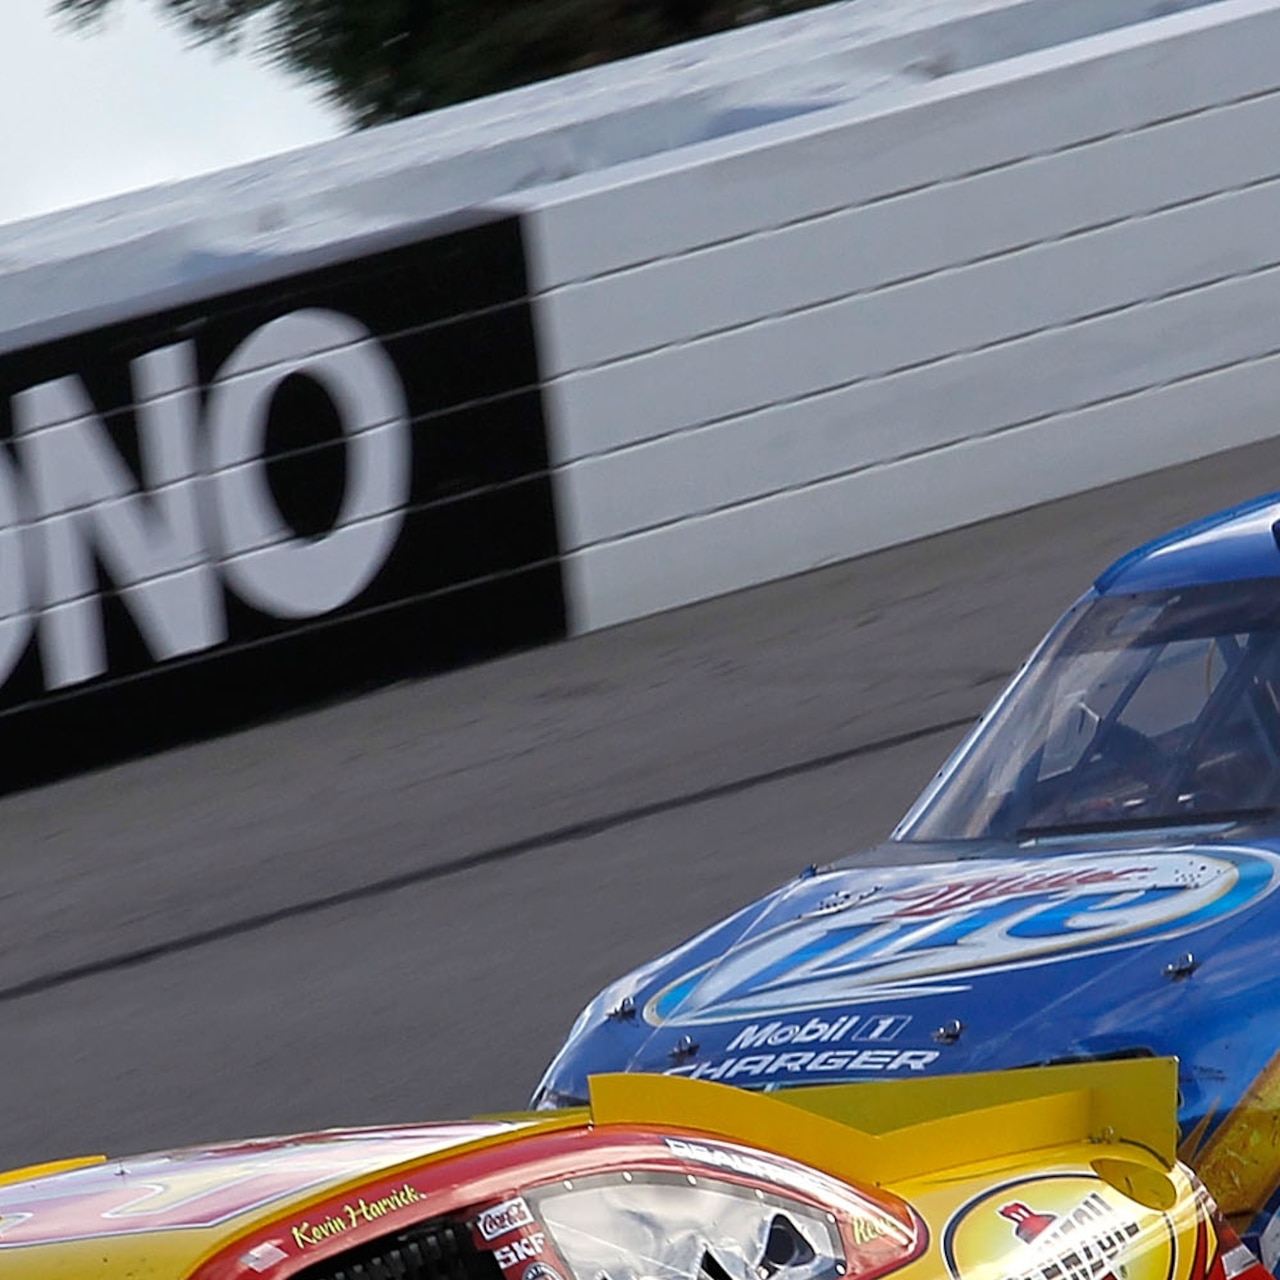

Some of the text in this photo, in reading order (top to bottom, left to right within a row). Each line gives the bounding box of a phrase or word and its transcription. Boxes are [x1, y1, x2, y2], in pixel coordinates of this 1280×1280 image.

[727, 1015, 859, 1051] Mobil
[291, 1184, 420, 1249] Kevin Harvick
[494, 1232, 546, 1269] SKF
